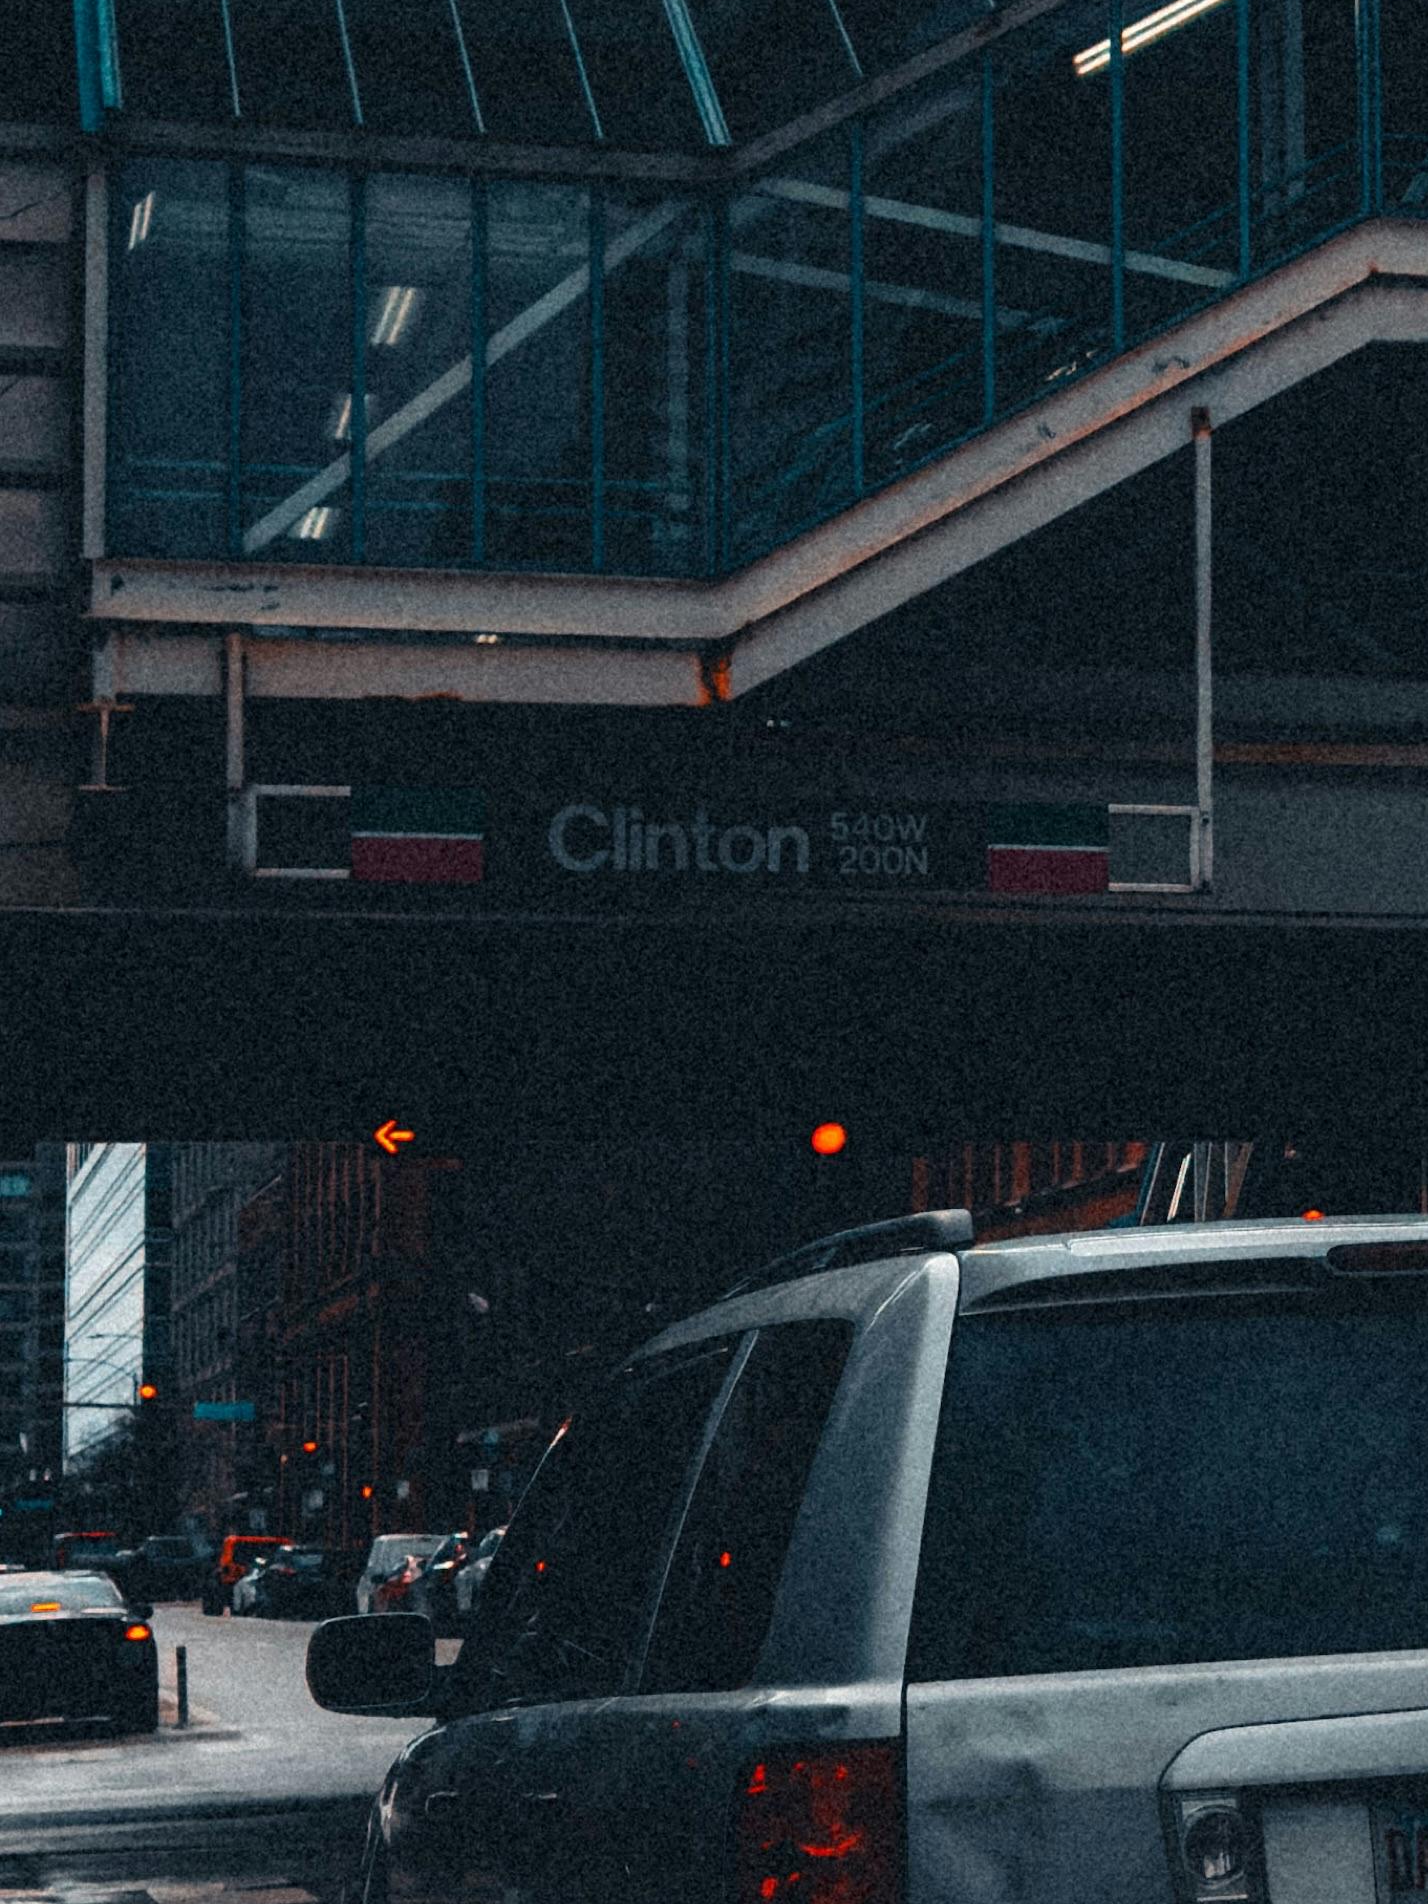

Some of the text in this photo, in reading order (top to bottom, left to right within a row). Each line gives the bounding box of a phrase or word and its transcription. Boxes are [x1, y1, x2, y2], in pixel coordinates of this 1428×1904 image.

[547, 803, 811, 873] Clinton
[829, 811, 929, 843] 540W
[838, 845, 930, 875] 200N
